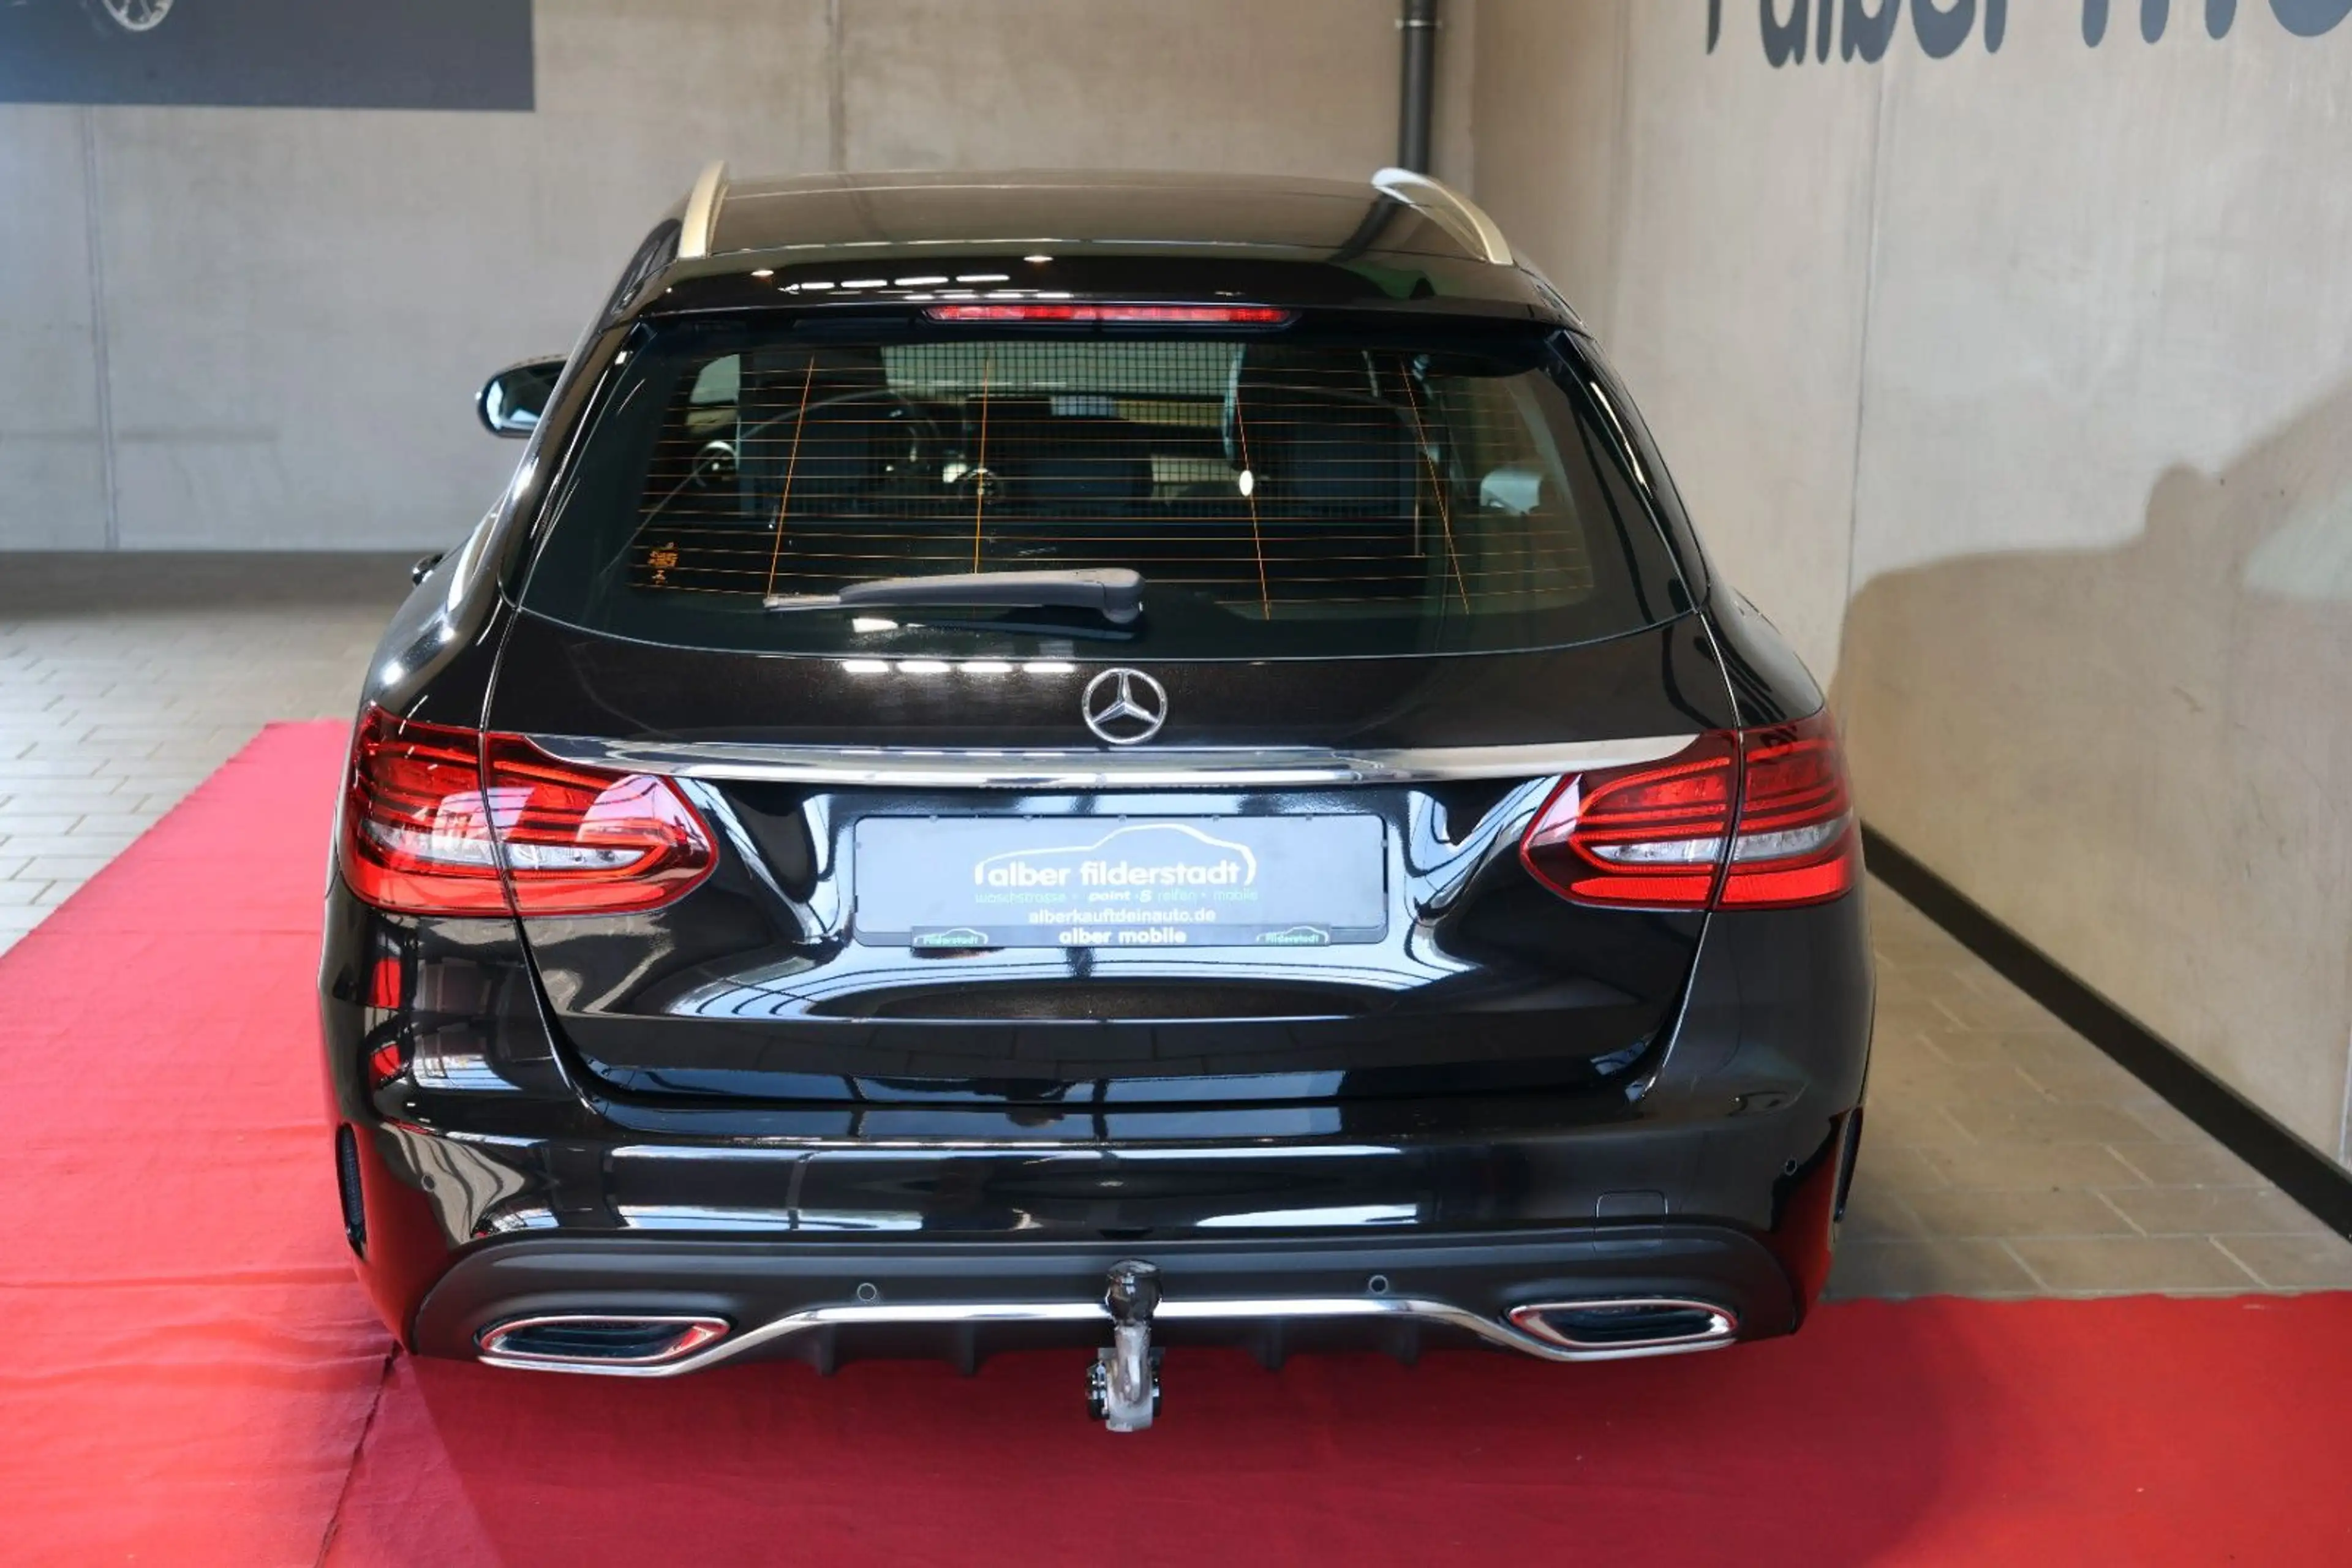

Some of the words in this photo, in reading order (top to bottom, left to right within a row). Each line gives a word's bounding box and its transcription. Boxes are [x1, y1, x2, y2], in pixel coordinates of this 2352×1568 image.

[988, 861, 1071, 887] alber
[1080, 860, 1241, 887] filderstadt
[1089, 891, 1130, 903] point
[1029, 908, 1216, 925] alberkauftdeinauto.de
[1059, 927, 1112, 944] alber
[1118, 927, 1187, 944] mobile
